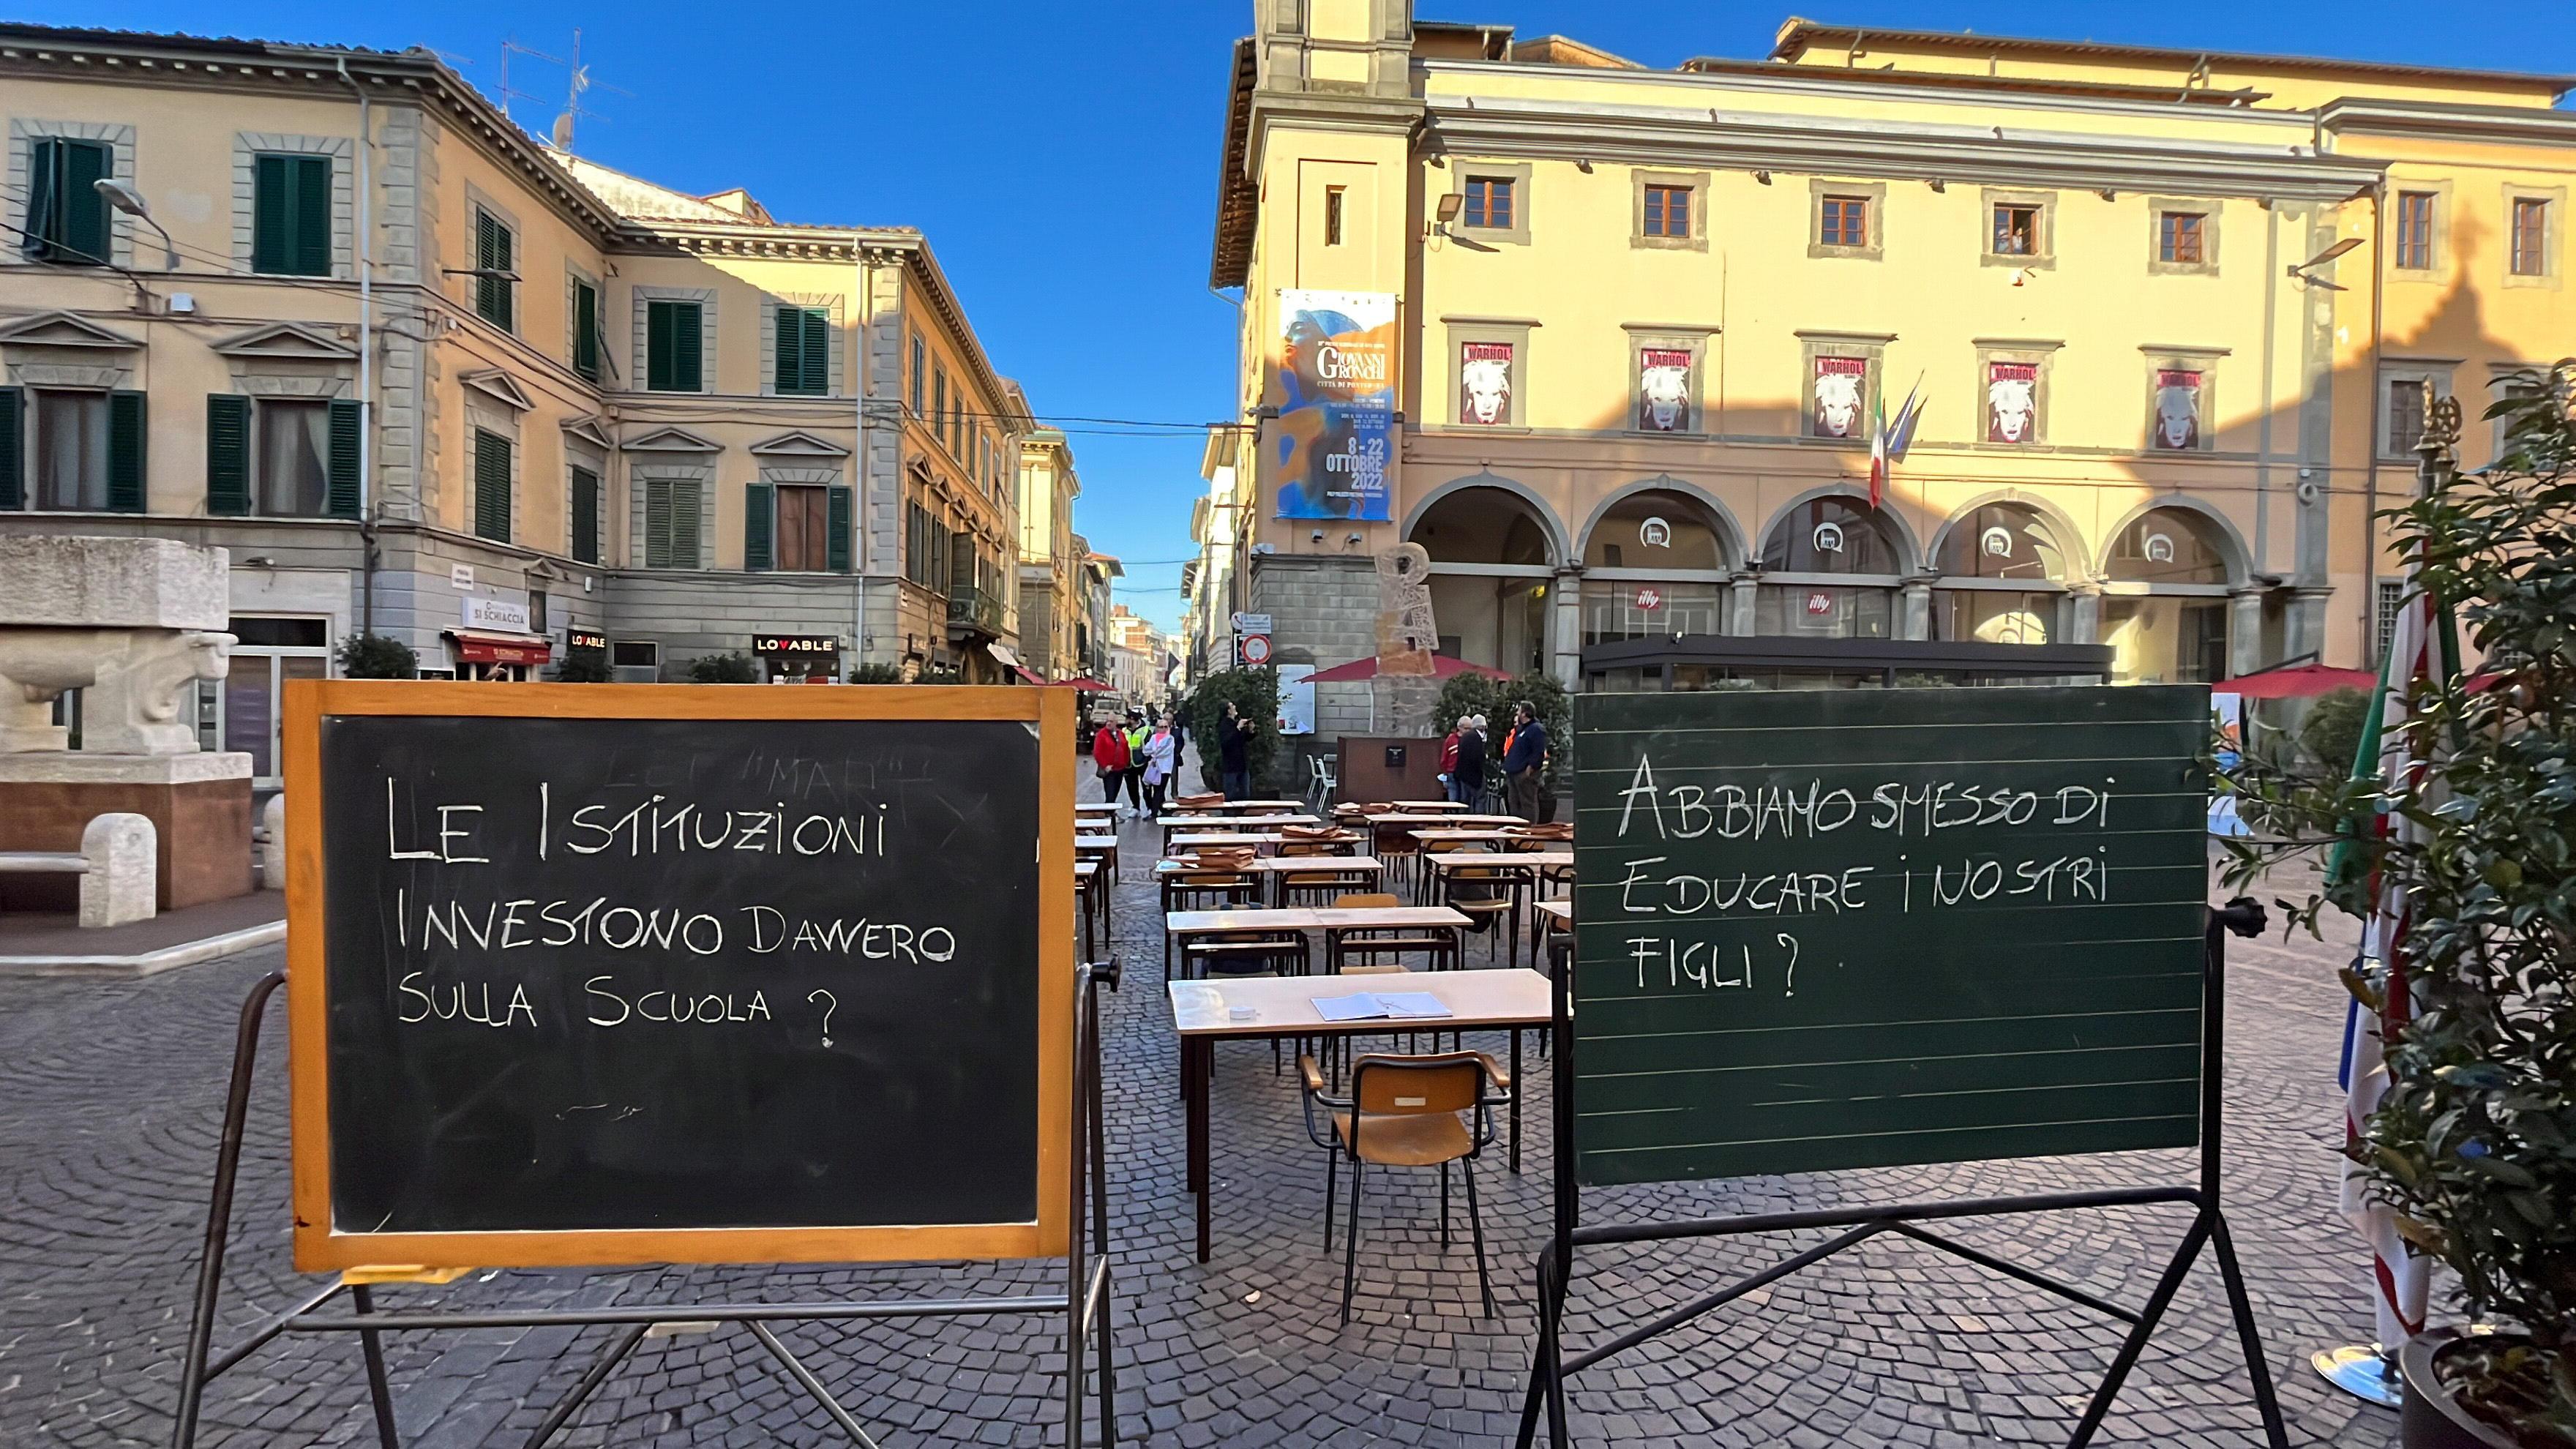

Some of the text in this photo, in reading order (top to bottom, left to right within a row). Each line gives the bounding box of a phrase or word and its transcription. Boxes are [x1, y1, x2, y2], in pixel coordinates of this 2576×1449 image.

[1469, 348, 1509, 360] WARHOL
[1648, 354, 1688, 367] WARHOL
[1822, 362, 1861, 374] WARHOL
[1996, 368, 2034, 380] WARHOL
[1348, 437, 1357, 454] 8
[1367, 438, 1384, 455] 22
[1326, 454, 1383, 472] OTTOBRE
[1351, 472, 1382, 490] 2022
[1637, 589, 1659, 608] illy
[1809, 594, 1830, 613] illy
[484, 611, 525, 624] SCHIACCIA
[572, 635, 605, 648] LOVABLE
[757, 639, 833, 651] LOVABLE
[1618, 752, 1858, 839] ABBIAMO
[1871, 782, 2038, 837] SMESSO
[389, 777, 489, 863] LE
[1620, 855, 1874, 916] EDUCARE
[399, 888, 722, 954] INVESTONO
[1625, 932, 1799, 997] FIGLI ?
[400, 972, 836, 1047] SULLA SCUOLA ?
